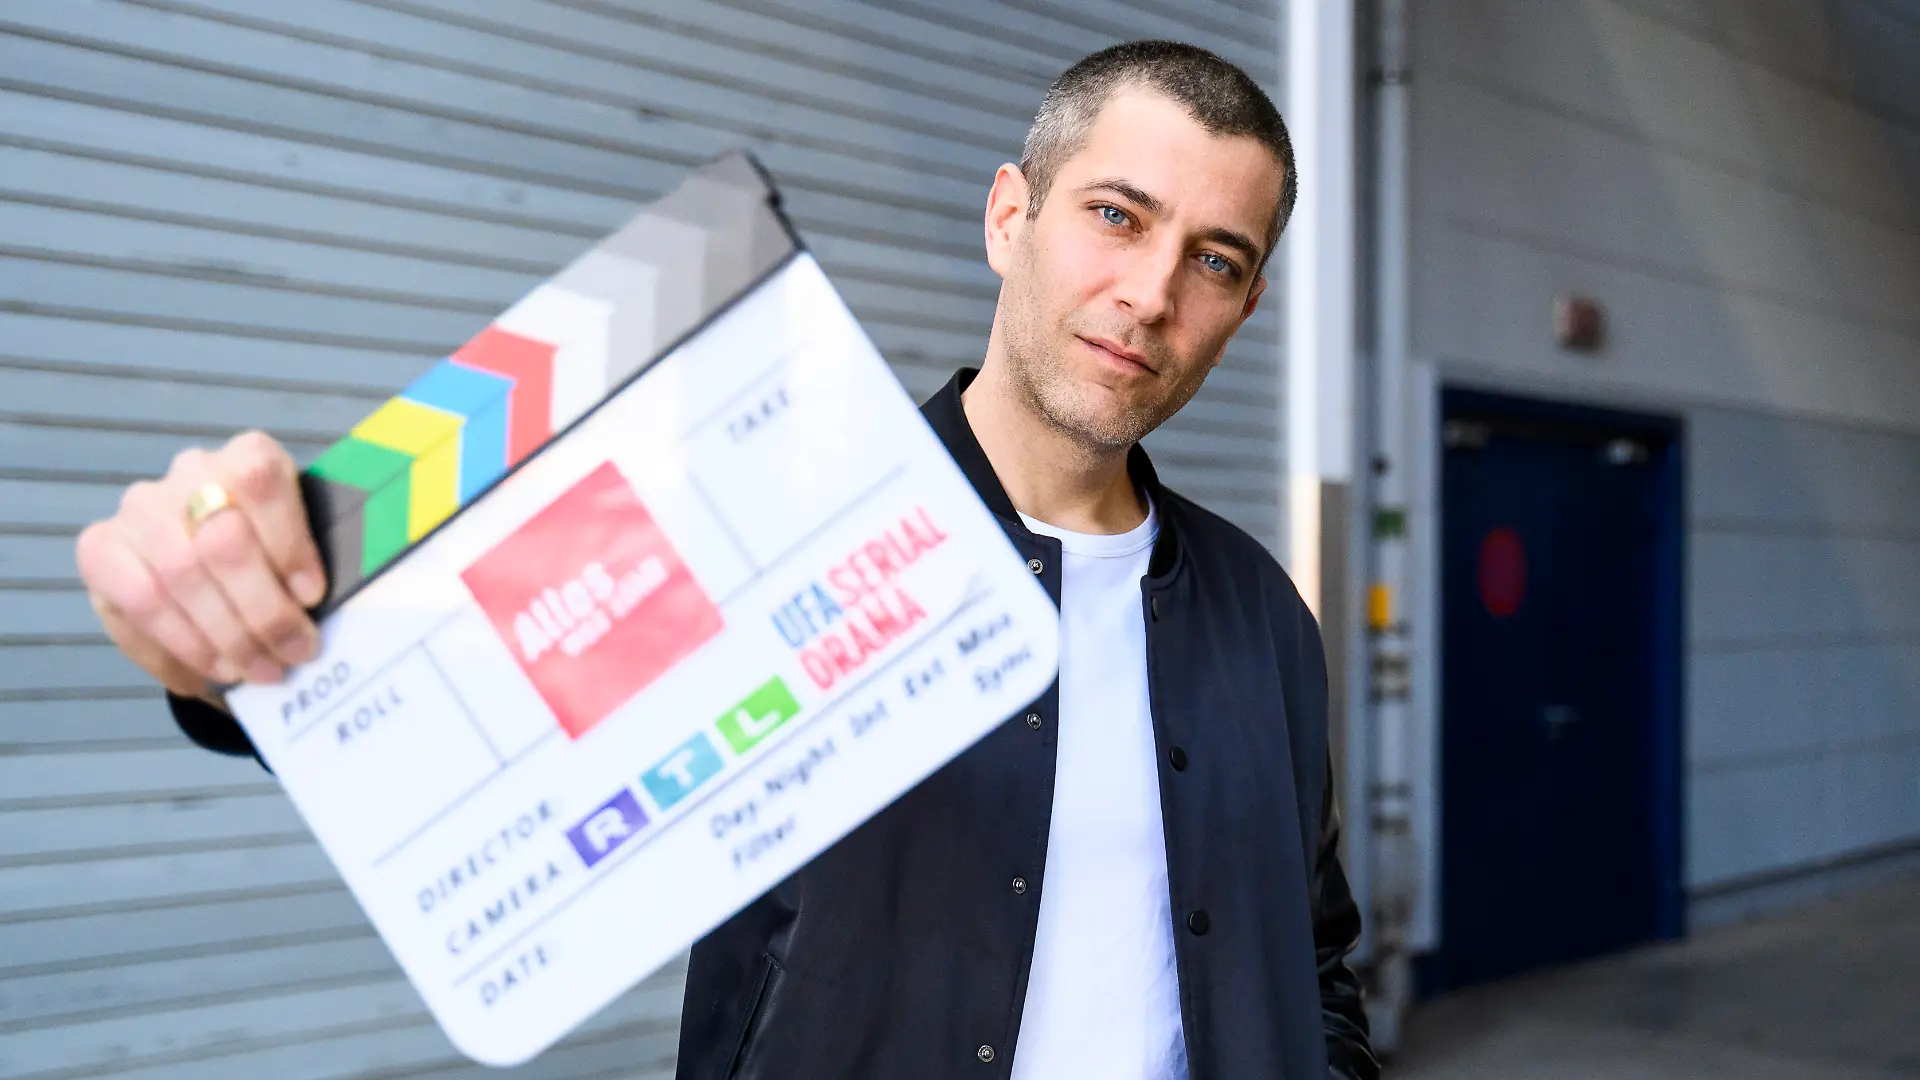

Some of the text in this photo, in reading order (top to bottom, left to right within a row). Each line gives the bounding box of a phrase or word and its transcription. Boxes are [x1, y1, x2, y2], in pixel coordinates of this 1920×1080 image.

[727, 387, 790, 443] TAKE
[513, 561, 615, 662] Alles
[800, 586, 927, 691] DRAMA
[336, 686, 404, 745] ROLL
